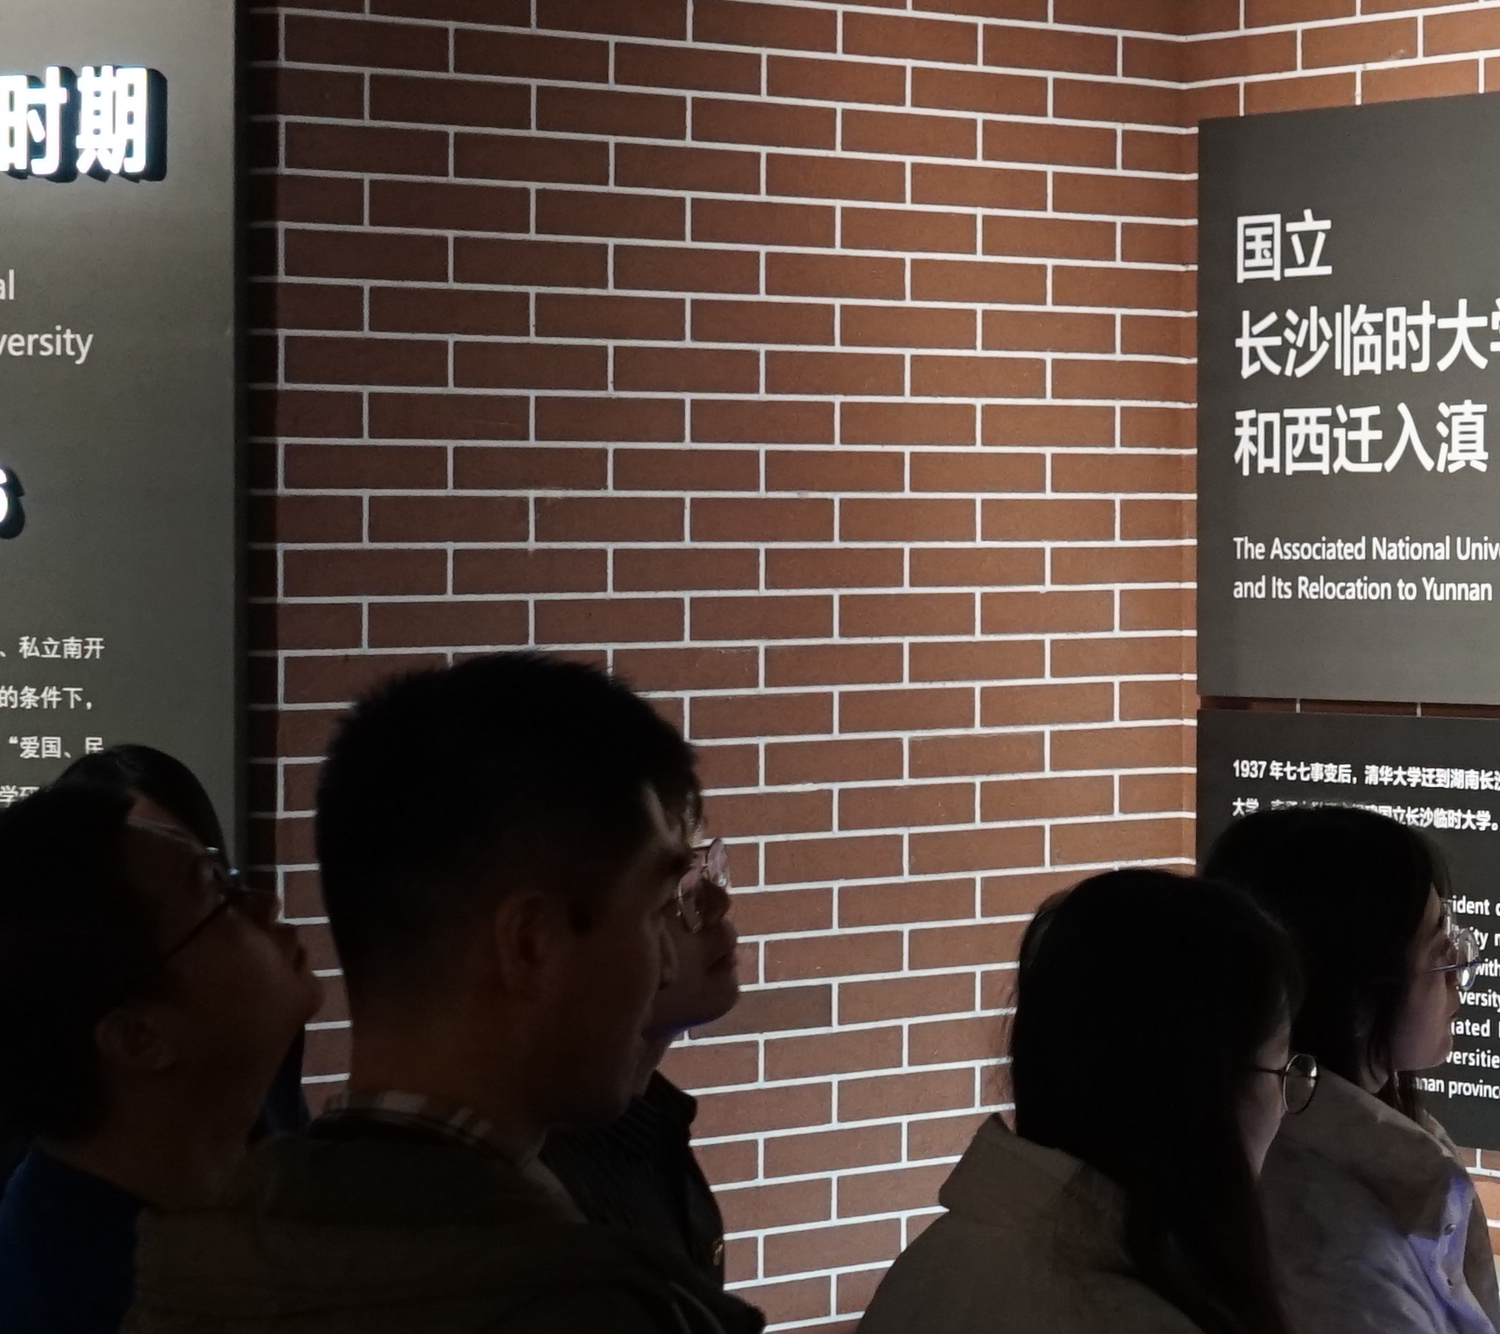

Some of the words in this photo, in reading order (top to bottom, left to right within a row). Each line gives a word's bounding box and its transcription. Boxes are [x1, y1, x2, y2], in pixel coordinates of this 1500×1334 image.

[1236, 209, 1332, 283] 国立
[1234, 400, 1488, 476] 和西迁入滇
[1233, 537, 1265, 559] The
[1271, 537, 1366, 561] Associated
[1372, 537, 1450, 561] National
[1233, 578, 1265, 599] and
[1271, 578, 1293, 599] Its
[1298, 578, 1392, 601] Relocation
[1398, 579, 1416, 601] to
[1422, 578, 1493, 602] Yunnan
[1448, 895, 1490, 915] ident
